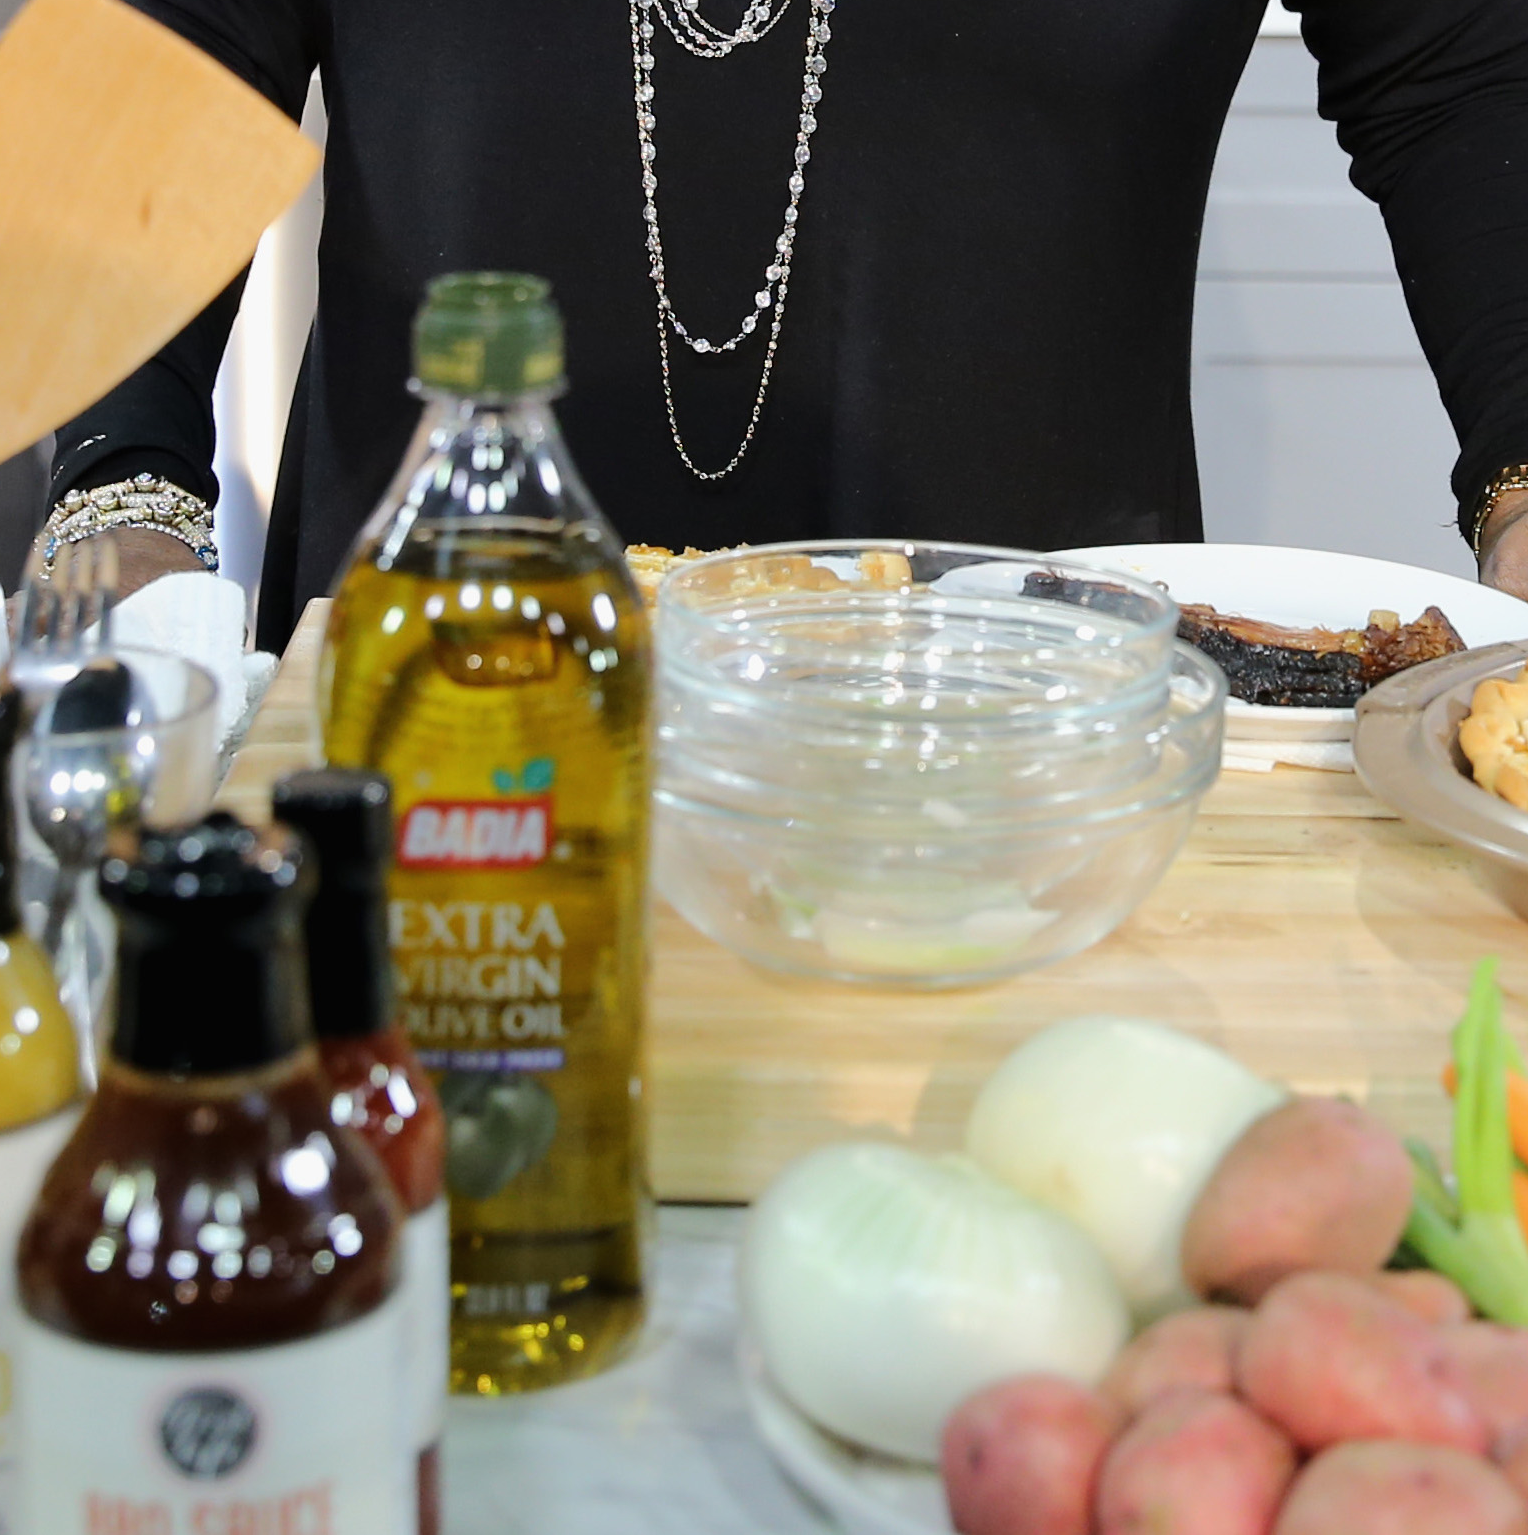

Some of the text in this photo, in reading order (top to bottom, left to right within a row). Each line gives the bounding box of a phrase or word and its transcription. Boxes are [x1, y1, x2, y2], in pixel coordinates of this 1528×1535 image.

[402, 806, 548, 861] BADIA
[386, 899, 565, 950] EXTRA
[393, 953, 564, 999] VIRGIN
[500, 1000, 568, 1041] OIL
